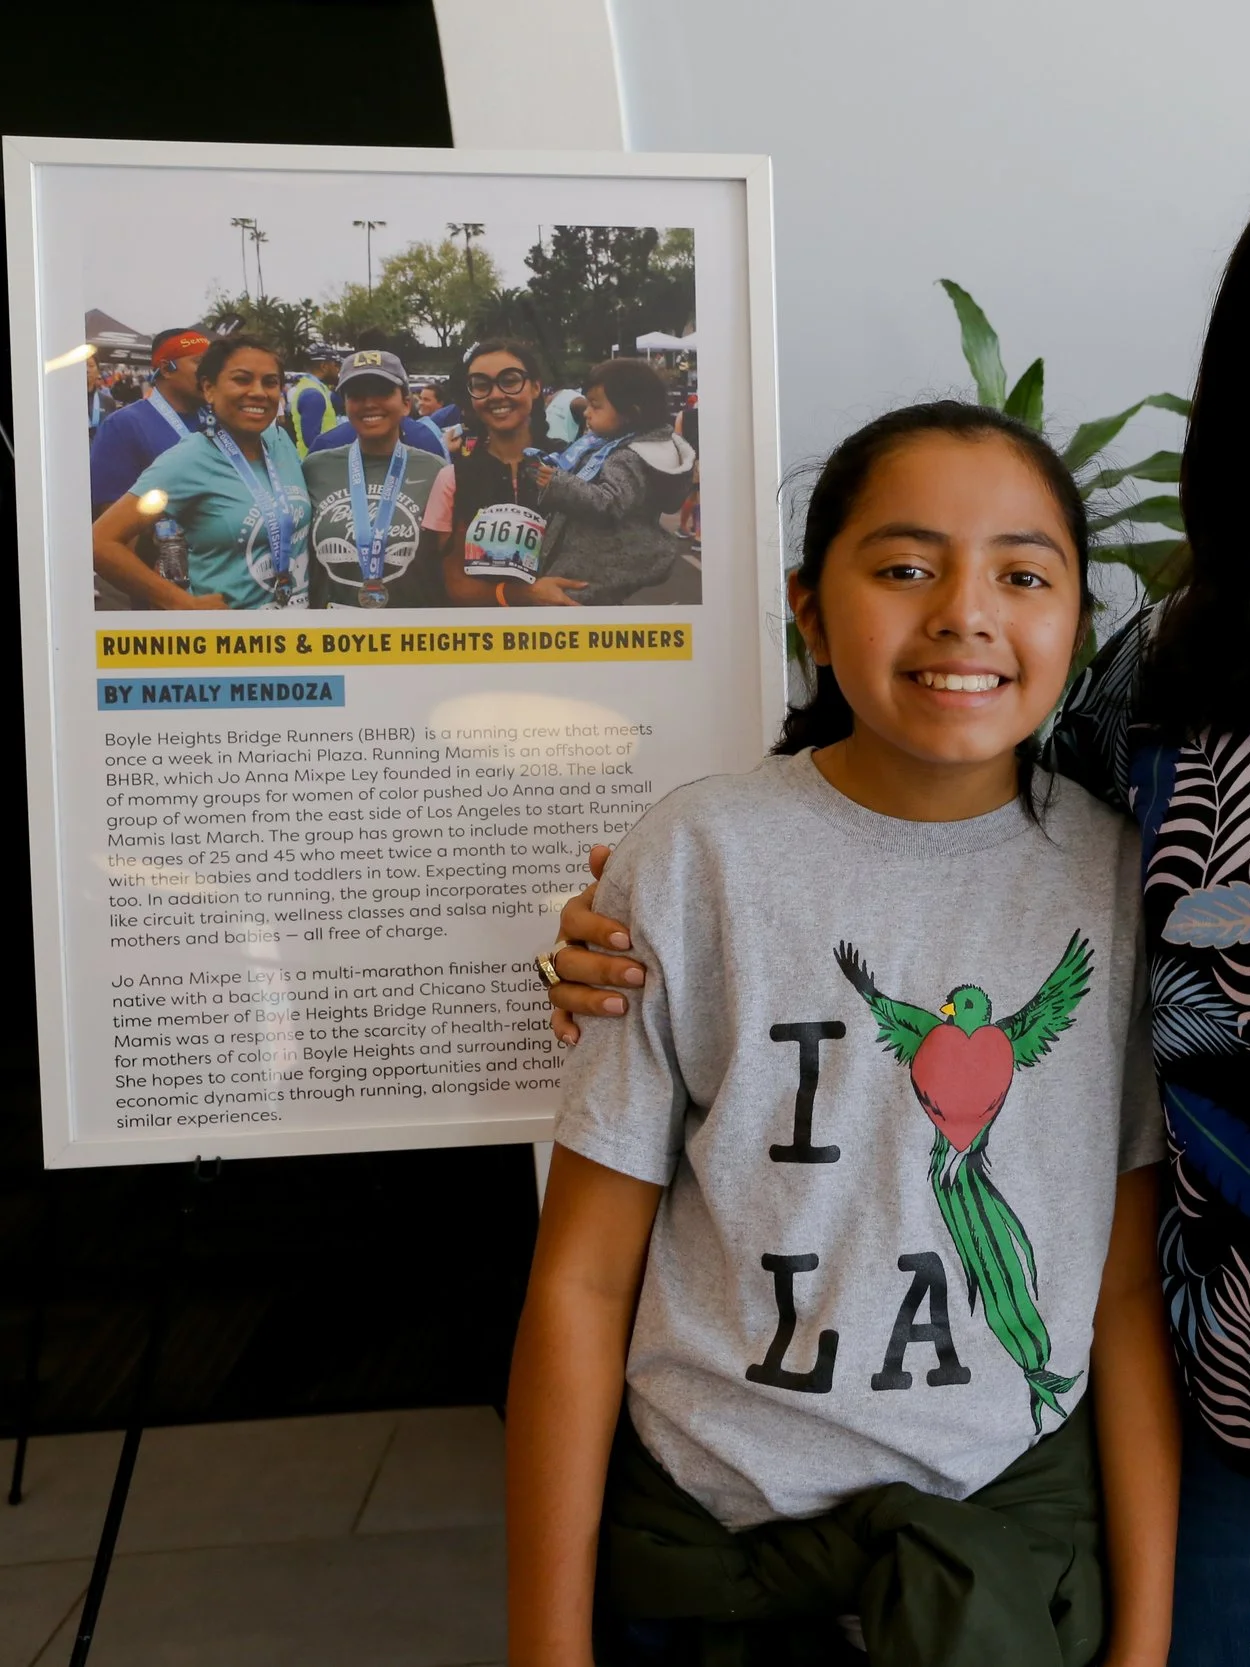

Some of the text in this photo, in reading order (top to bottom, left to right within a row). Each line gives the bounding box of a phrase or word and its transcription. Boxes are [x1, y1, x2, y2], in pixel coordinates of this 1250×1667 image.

[353, 353, 382, 367] LA
[473, 521, 539, 550] 51616
[103, 629, 685, 656] RUNNING MAMIS & BOYLE HEIGHTS BRIDGE RUNNERS
[104, 682, 332, 704] BY NATALY MENDOZA
[105, 723, 653, 749] Boyle Heights Bridge Runners (BHBR) meets
[105, 745, 499, 766] once week Mariachi Plaza. Running Mamis
[164, 771, 213, 785] which
[245, 770, 288, 783] Anna
[294, 768, 345, 785] Mixpe
[352, 768, 378, 784] Ley
[383, 765, 451, 780] founded
[475, 764, 515, 780] early
[566, 763, 596, 776] The
[601, 761, 633, 775] lack
[128, 780, 651, 808] mommy groups women color pushed Anna small
[106, 803, 585, 831] group women from east side Los Angeles start
[108, 821, 599, 847] Mamis last March. The group grown include mothers
[142, 843, 505, 869] ages who meet twice month
[108, 863, 561, 887] with babies toddlers tow. Expecting moms
[109, 896, 142, 908] too.
[168, 891, 239, 906] addition
[372, 888, 421, 903] group
[426, 883, 527, 899] incorporates
[531, 881, 571, 895] other
[110, 914, 138, 927] like
[143, 912, 195, 926] circuit
[274, 908, 343, 922] wellness
[348, 906, 405, 920] classes
[446, 902, 486, 916] salsa
[492, 900, 534, 918] night
[110, 925, 447, 947] mothers babies free charge.
[139, 961, 507, 987] Anna Mixpe multi-marathon finisher
[113, 978, 549, 1008] native with background art Chicano Studies
[113, 1015, 152, 1028] time
[158, 1011, 229, 1026] member
[256, 1009, 301, 1024] Boyle
[306, 1006, 368, 1023] Heights
[374, 1003, 427, 1020] Bridge
[114, 1023, 426, 1048] Mamis response scarcity
[142, 1037, 552, 1067] mothers color Boyle Heights surrounding
[116, 1060, 481, 1089] She hopes continue forging opportunities
[116, 1092, 198, 1109] economic
[204, 1088, 285, 1107] dynamics
[289, 1085, 355, 1102] through
[432, 1078, 511, 1096] alongside
[769, 1020, 847, 1164] I
[117, 1110, 282, 1129] similar experiences.
[745, 1251, 972, 1394] LA
